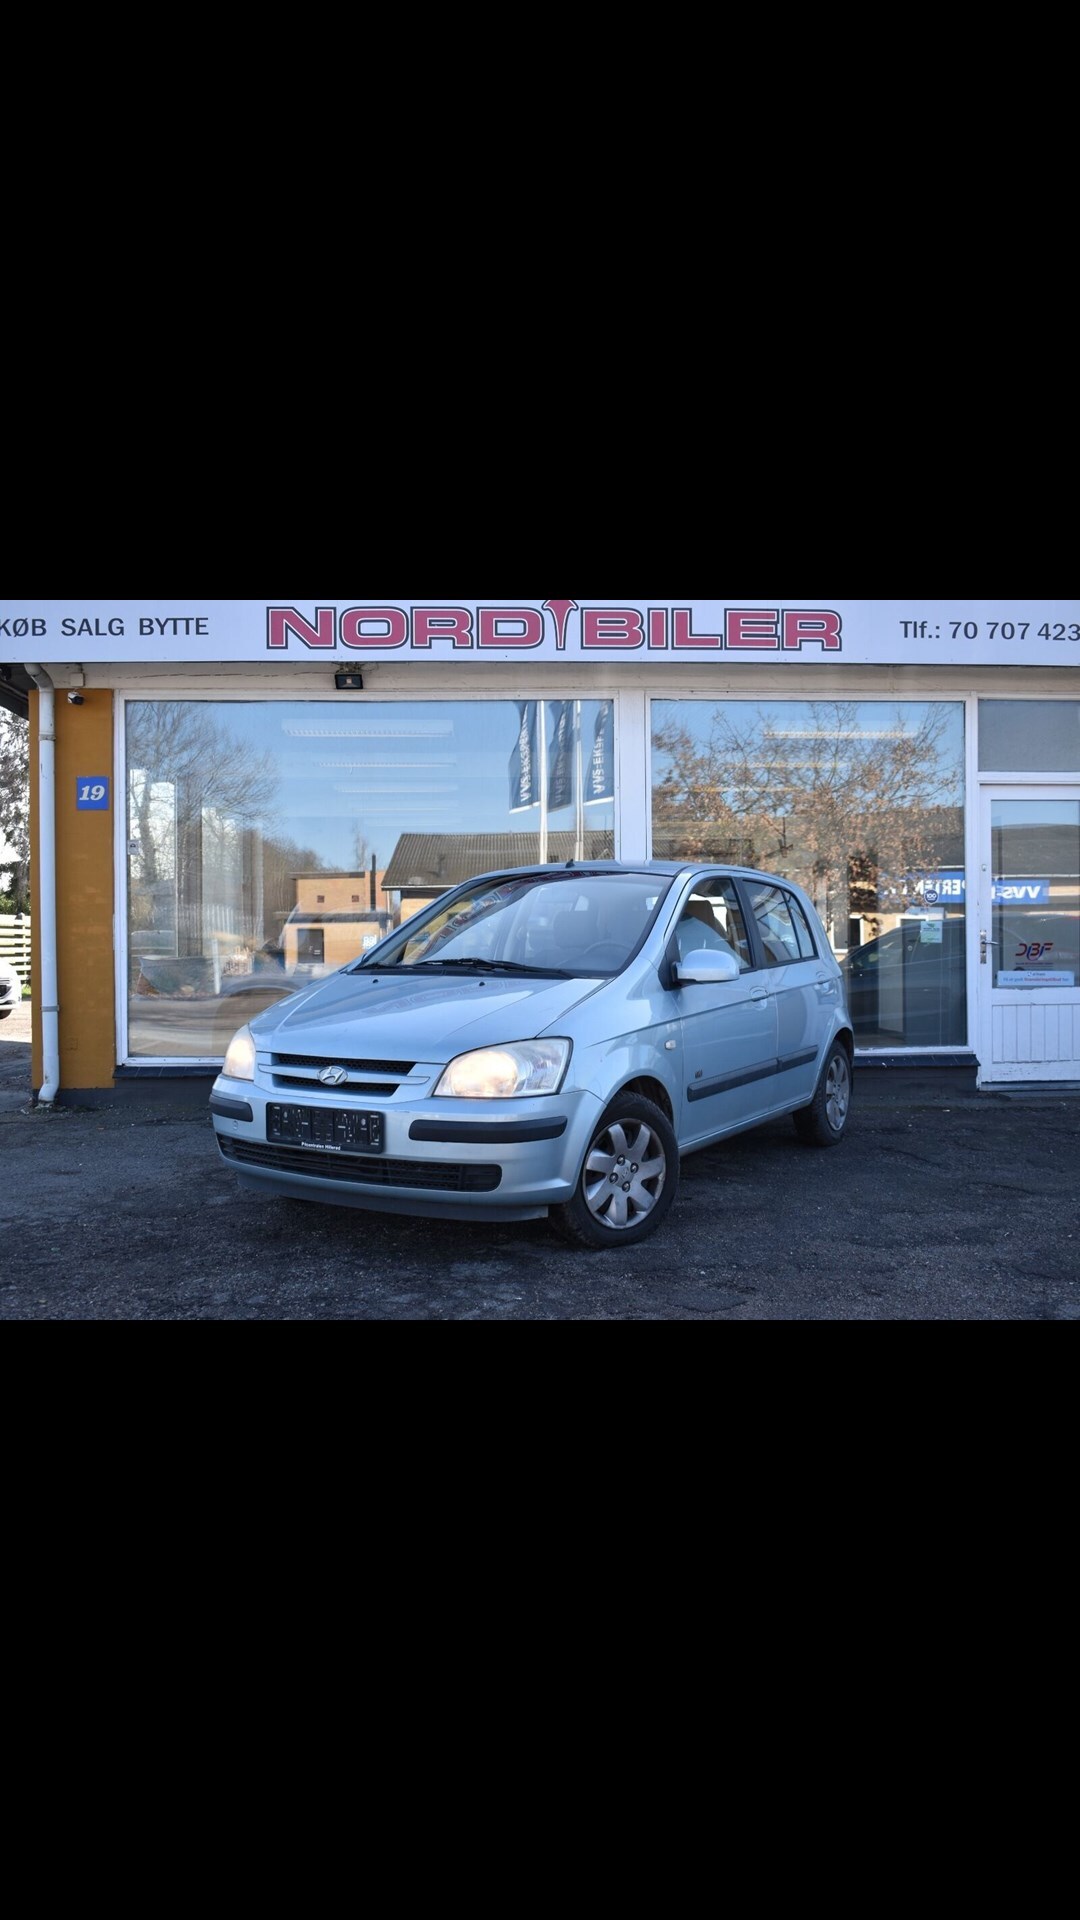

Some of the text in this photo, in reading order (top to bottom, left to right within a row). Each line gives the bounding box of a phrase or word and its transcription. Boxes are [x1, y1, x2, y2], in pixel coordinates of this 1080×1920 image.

[0, 618, 208, 637] KØB SALG BYTTE
[266, 606, 842, 651] NORD BILER
[900, 621, 1080, 641] Tlf.: 70 707 423
[79, 785, 105, 801] 19
